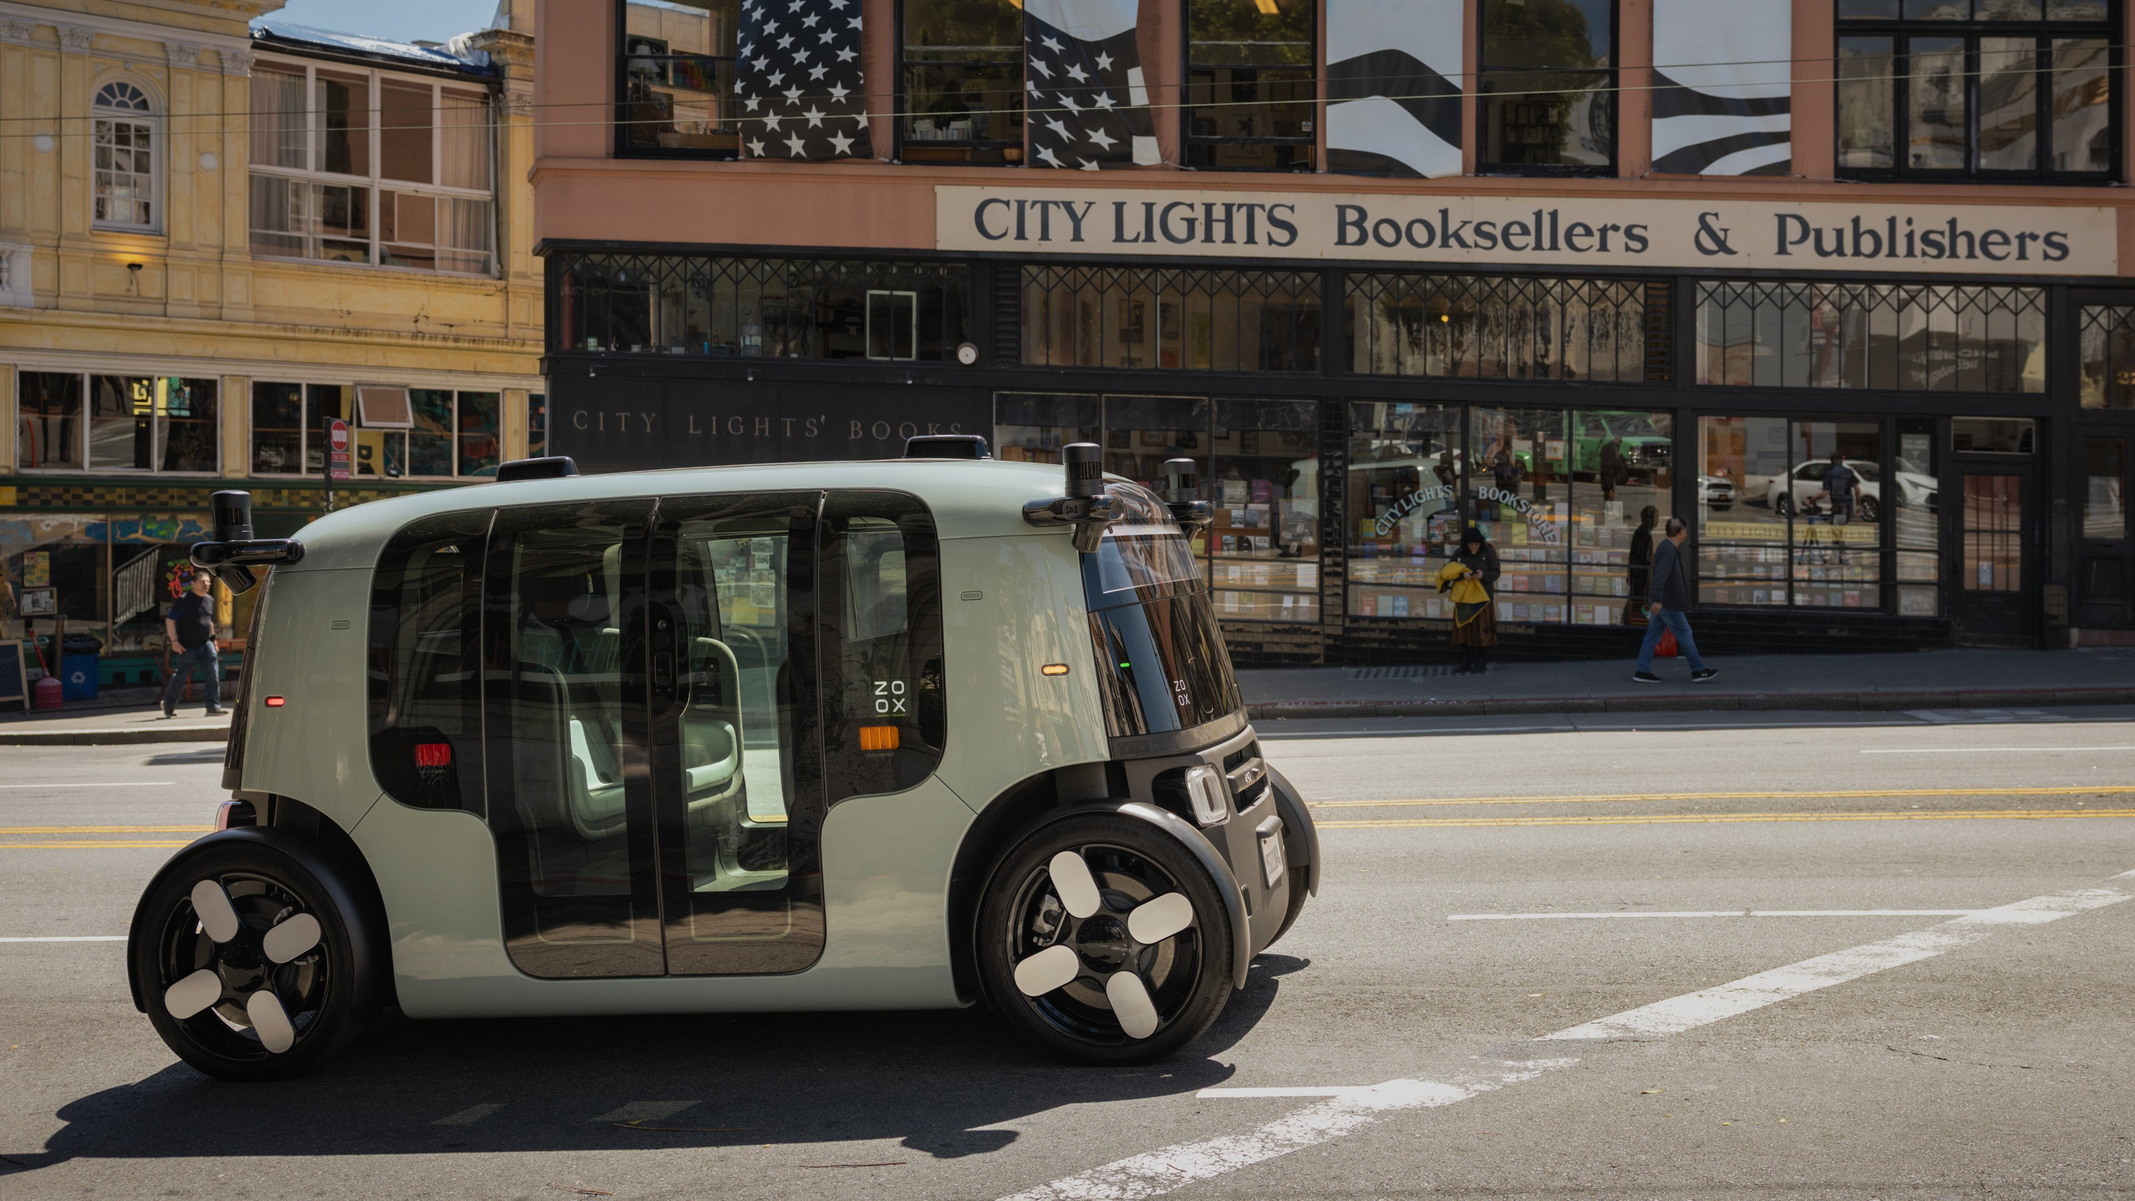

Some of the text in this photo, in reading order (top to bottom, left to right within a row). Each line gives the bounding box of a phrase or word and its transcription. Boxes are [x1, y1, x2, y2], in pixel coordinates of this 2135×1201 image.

[975, 197, 2070, 263] CITY LIGHTS Booksellers & Publishers
[572, 410, 658, 434] CITY
[849, 421, 962, 440] BOOKS
[1376, 484, 1558, 546] CITY LIGHTS BOOKSTORE
[1708, 526, 1738, 537] CITY
[1742, 526, 1787, 538] LIGHTS
[874, 681, 904, 695] ZO
[876, 698, 906, 713] OX
